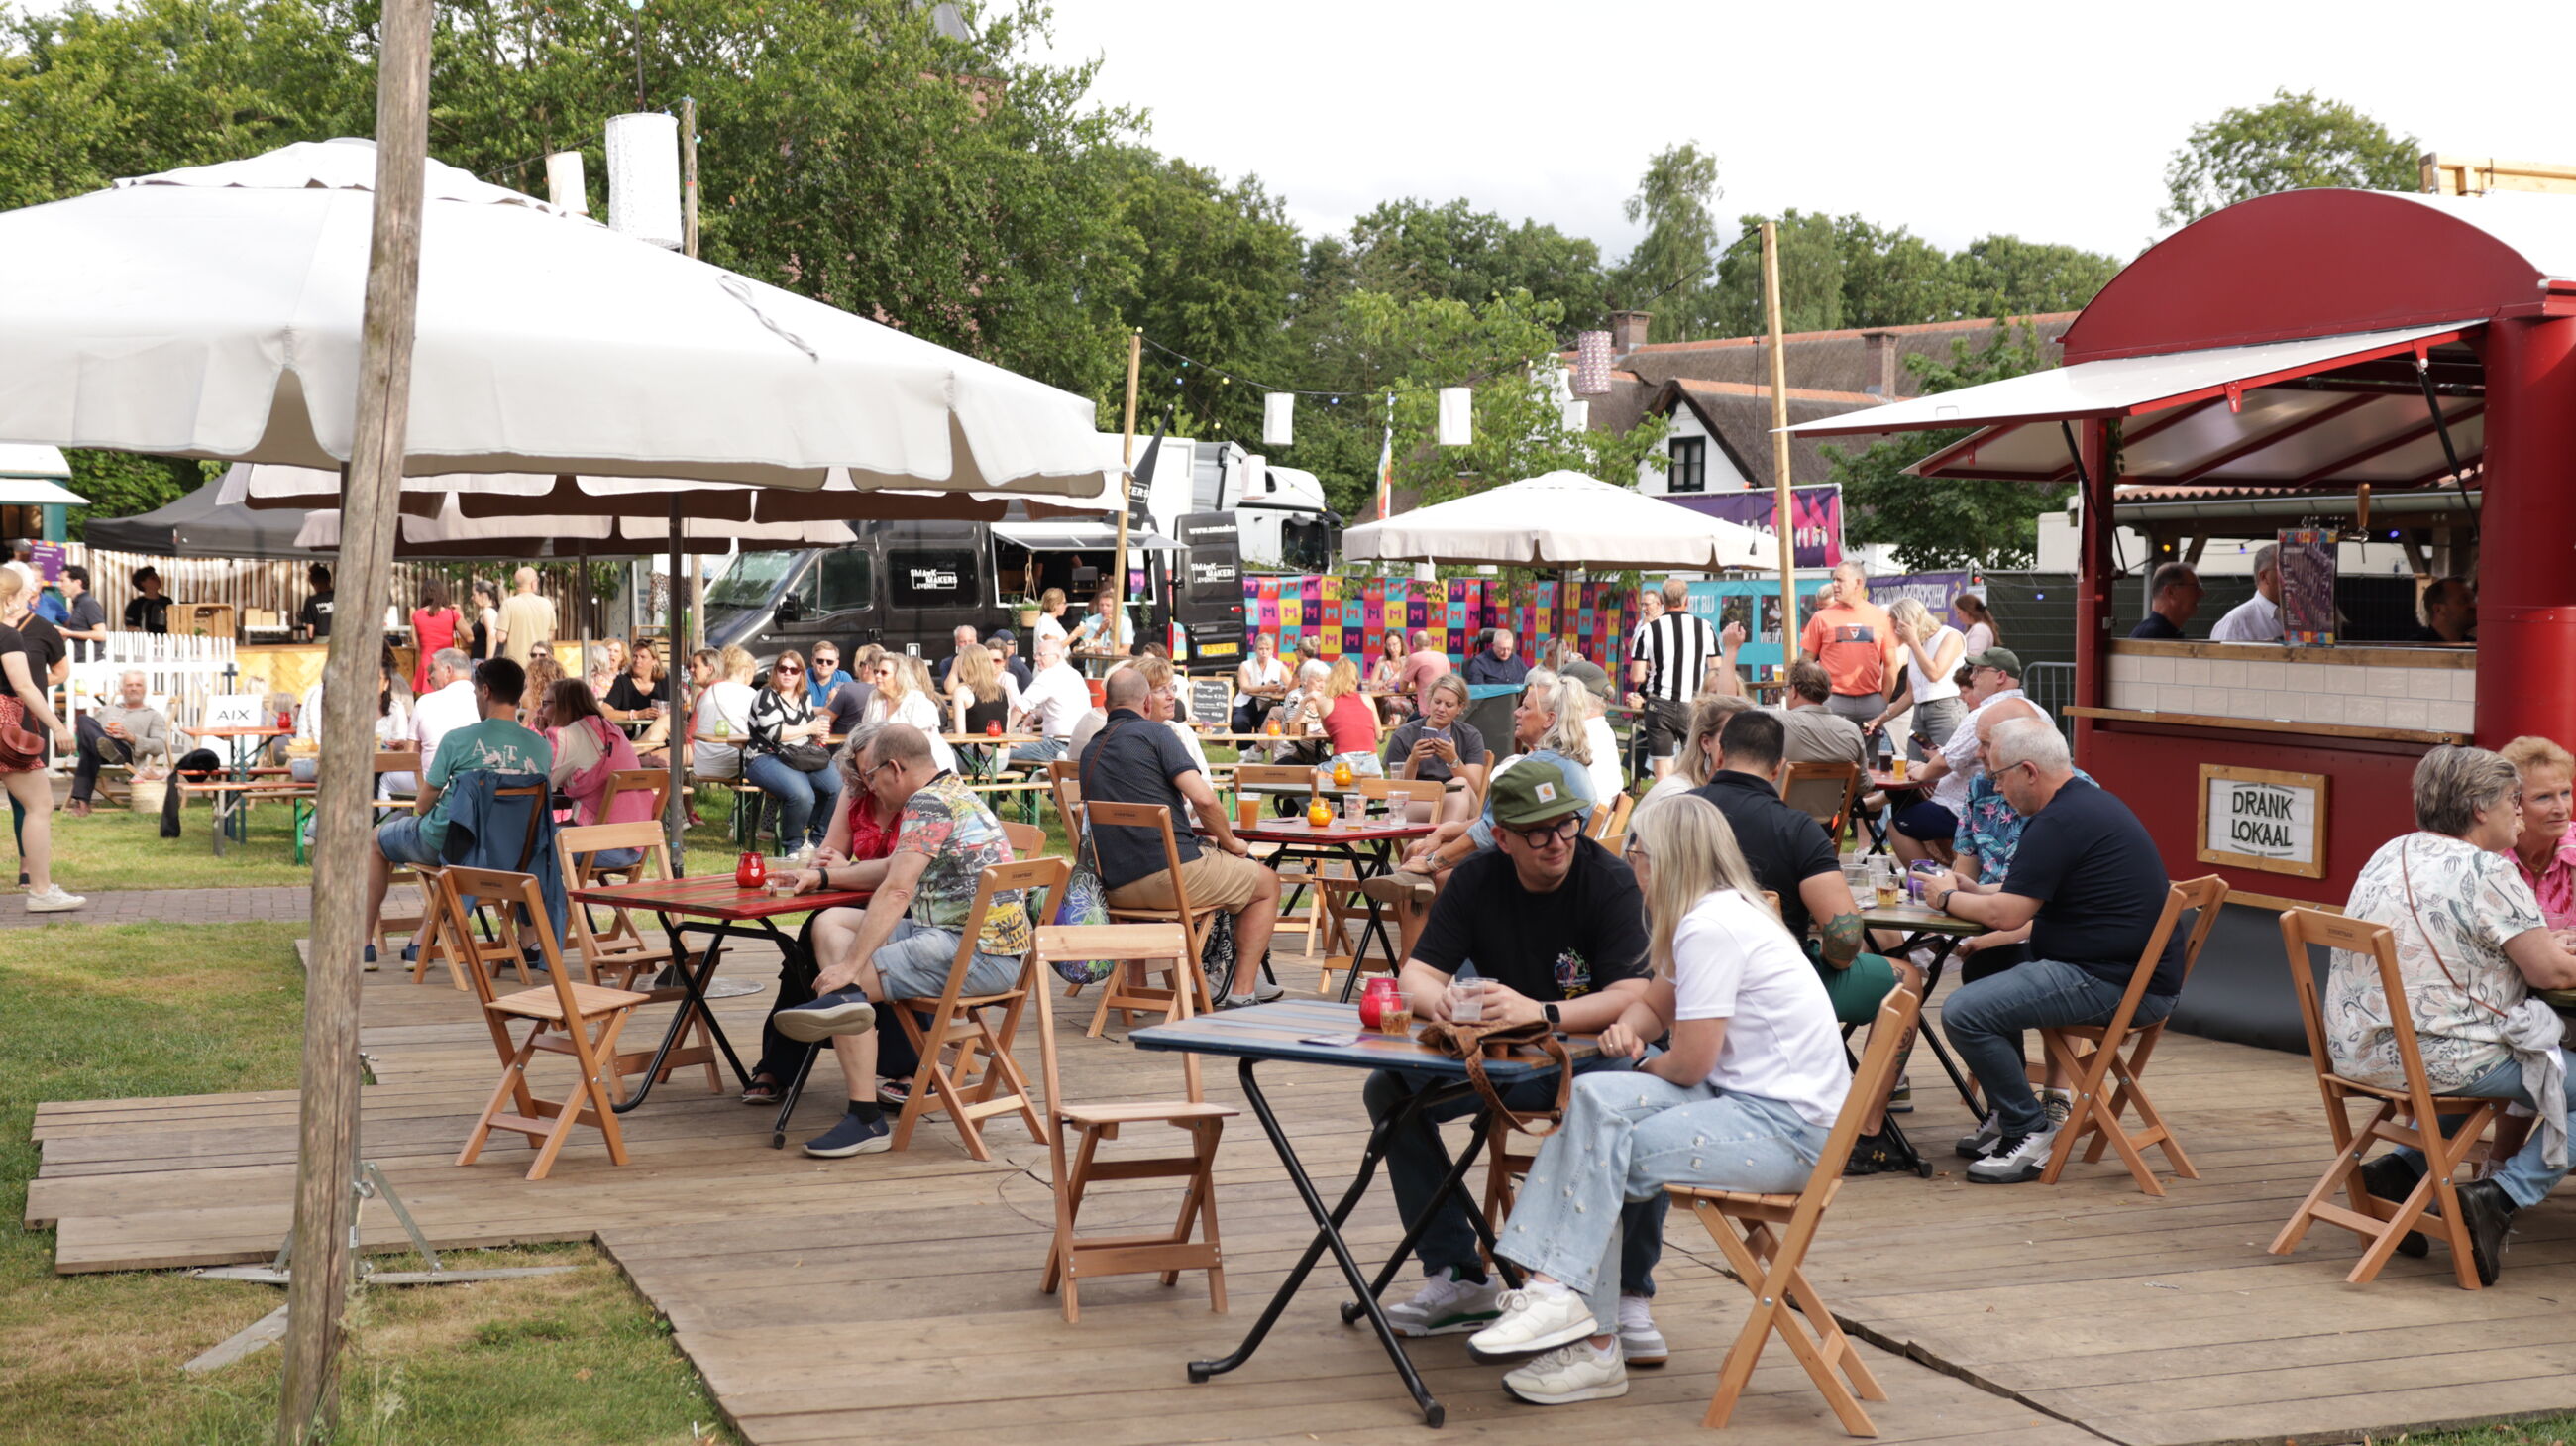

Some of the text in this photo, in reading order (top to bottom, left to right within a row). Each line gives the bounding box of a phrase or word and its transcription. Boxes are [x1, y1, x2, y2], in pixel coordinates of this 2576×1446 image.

[217, 710, 250, 720] AIX
[2232, 791, 2293, 820] DRANK
[2231, 819, 2293, 846] LOKAAL
